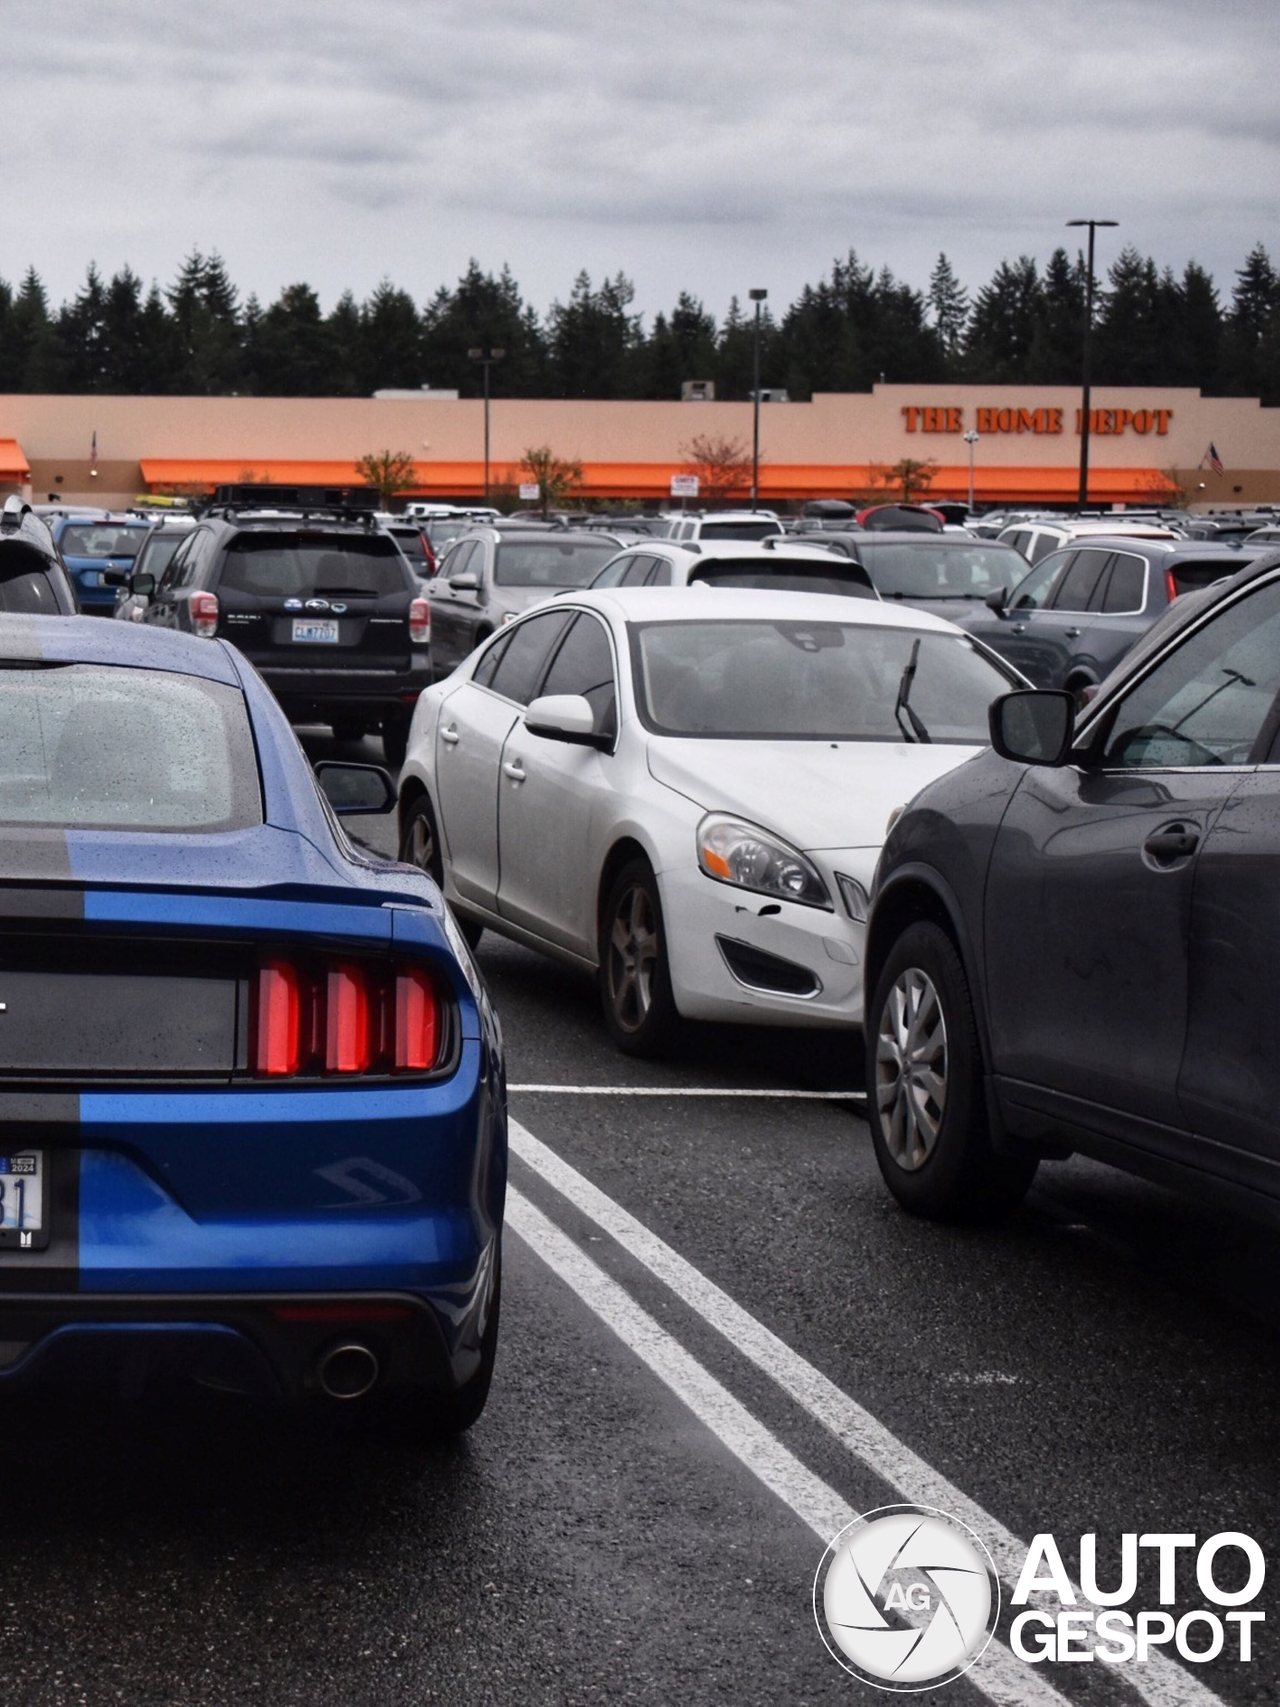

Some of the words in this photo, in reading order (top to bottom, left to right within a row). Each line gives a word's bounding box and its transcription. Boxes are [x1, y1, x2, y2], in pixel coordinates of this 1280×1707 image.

[902, 407, 963, 433] THE
[976, 408, 1063, 434] HOME
[1076, 409, 1174, 435] DEPOT
[11, 1164, 34, 1172] 2024
